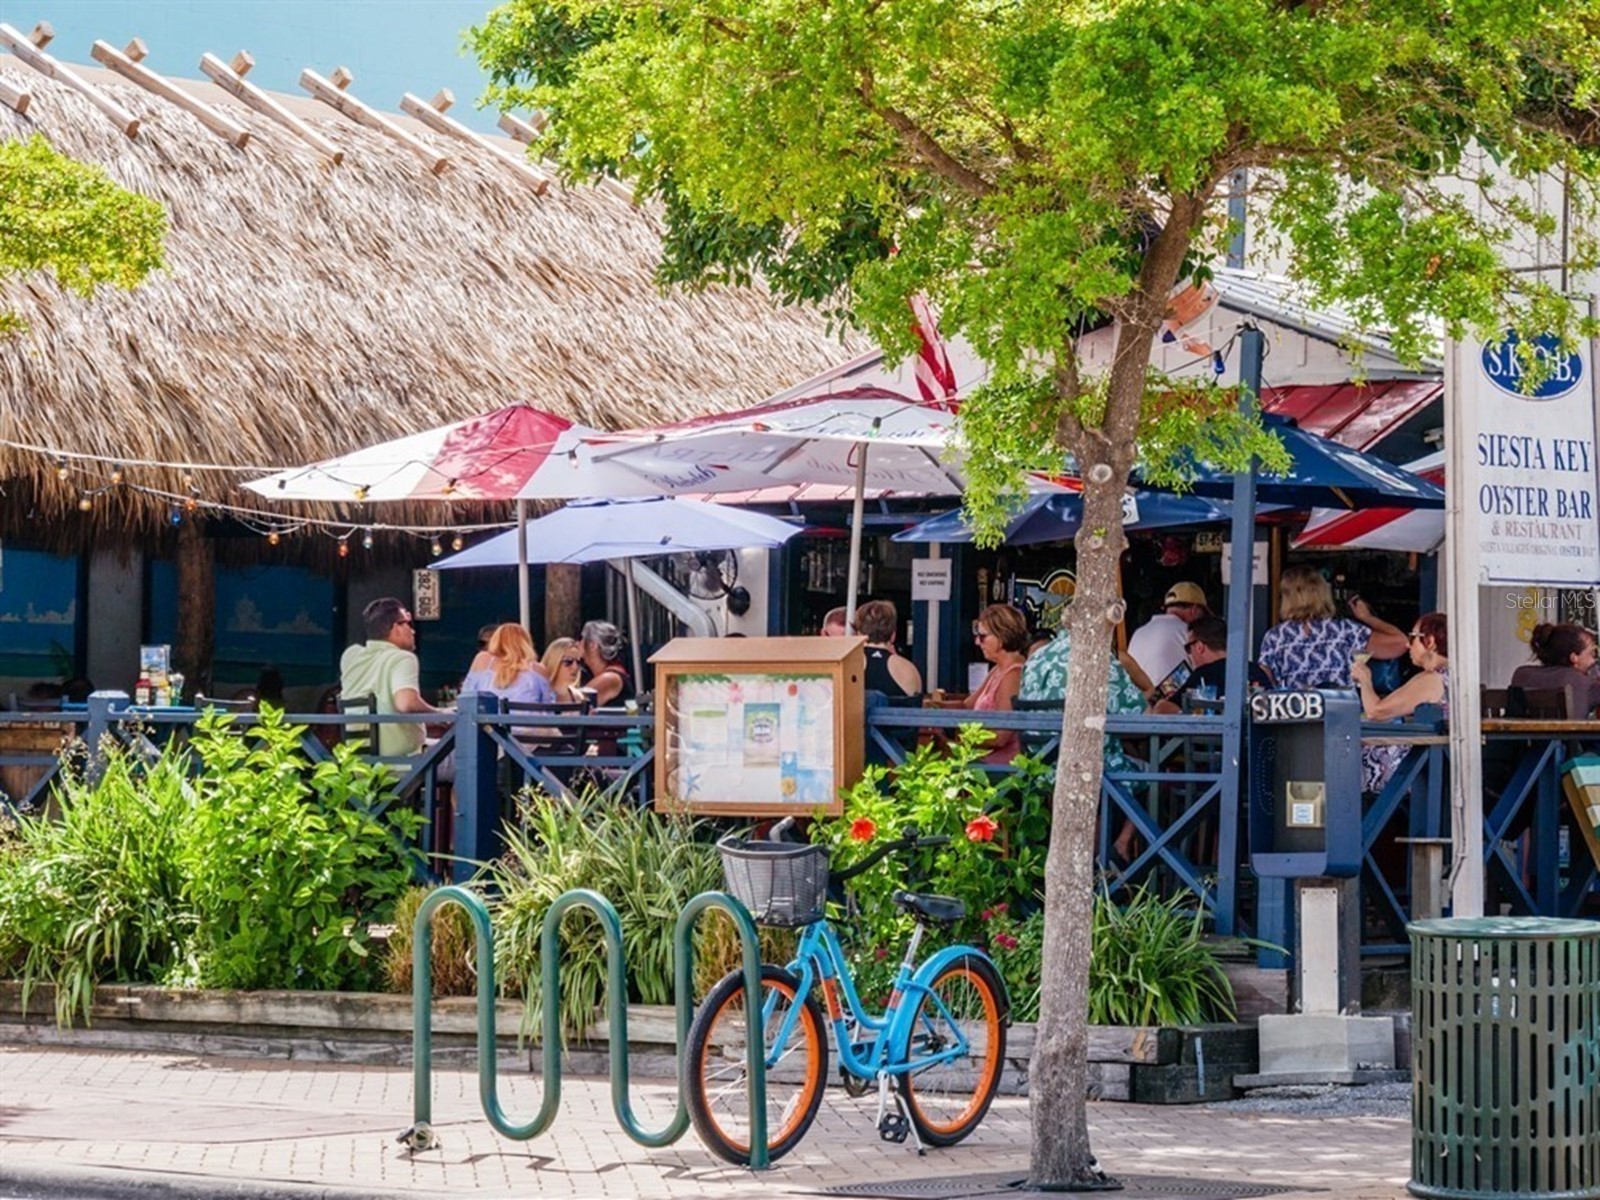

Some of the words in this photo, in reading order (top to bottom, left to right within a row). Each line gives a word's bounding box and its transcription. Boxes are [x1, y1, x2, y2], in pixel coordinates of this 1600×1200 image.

[1478, 433, 1546, 469] SIESTA
[1553, 439, 1591, 472] KEY
[1480, 484, 1549, 516] OYSTER
[1557, 489, 1592, 519] BAR
[1491, 521, 1500, 536] &
[1505, 520, 1583, 540] RESTAURANT
[1251, 693, 1323, 720] SKOB
